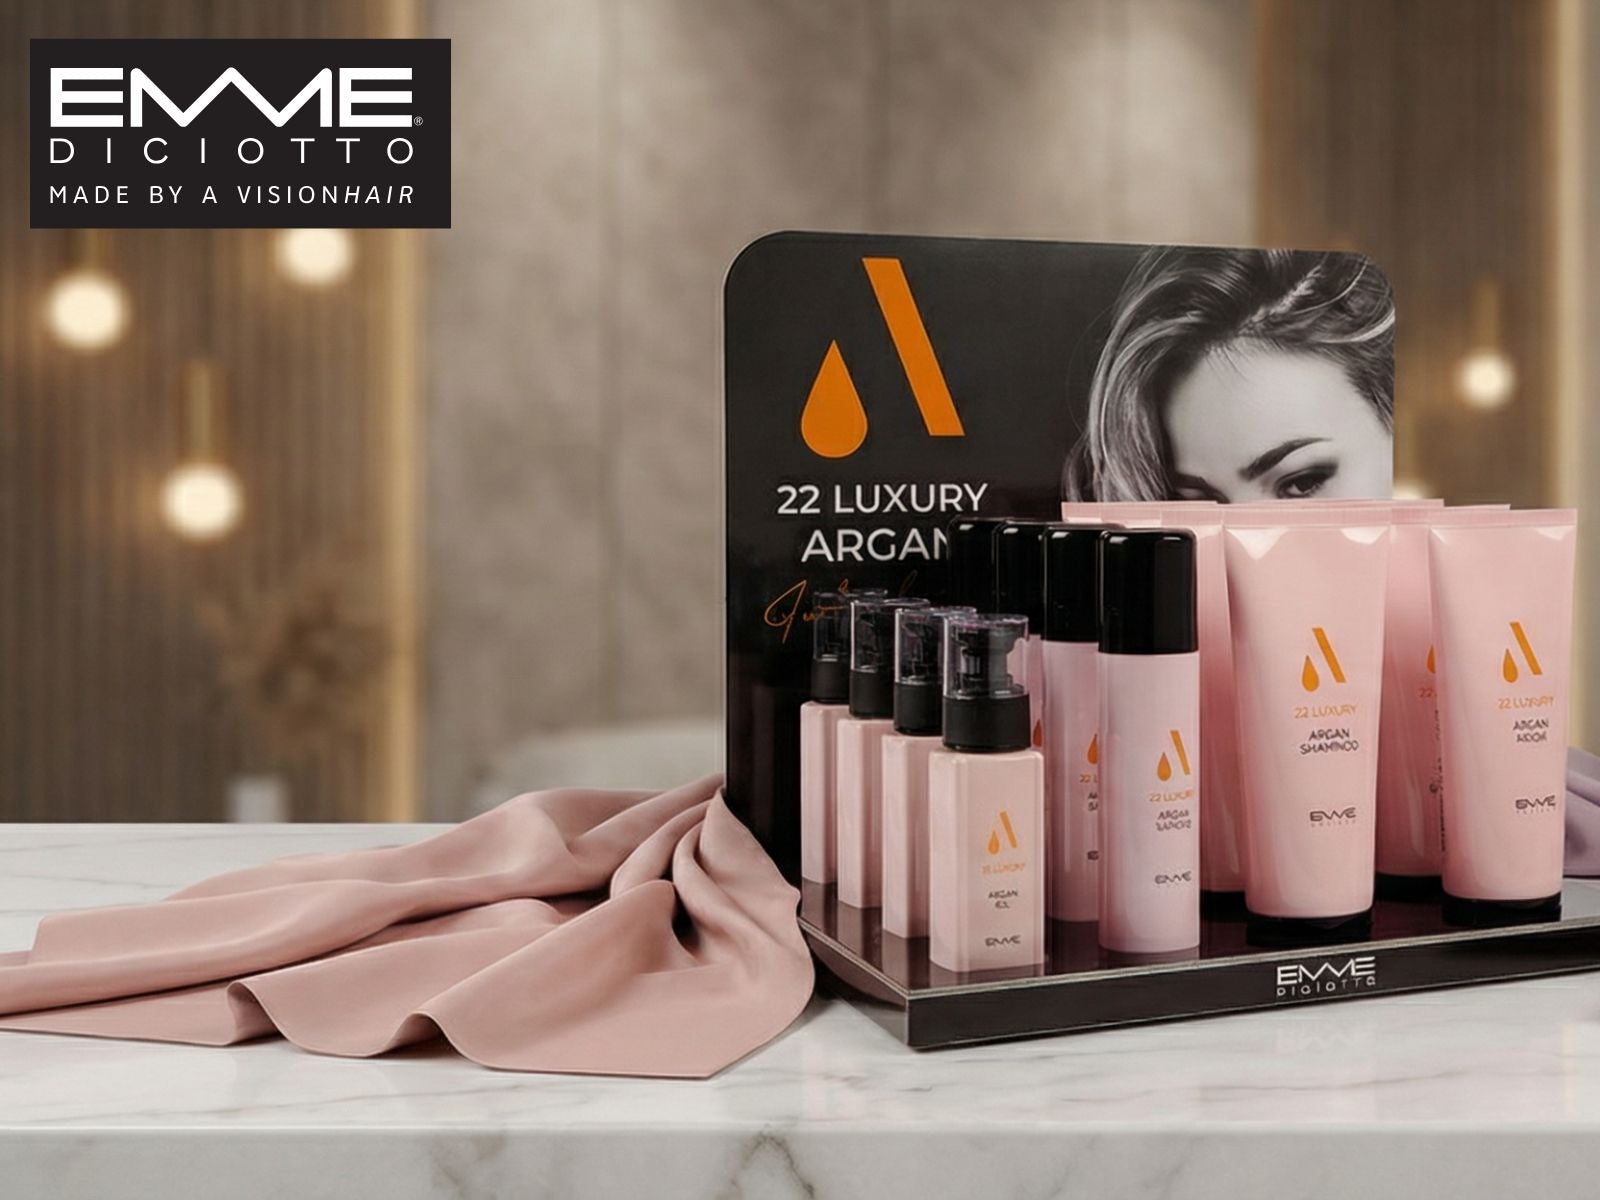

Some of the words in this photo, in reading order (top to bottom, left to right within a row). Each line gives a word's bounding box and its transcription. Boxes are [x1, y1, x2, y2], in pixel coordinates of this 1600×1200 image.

[777, 484, 821, 515] 22
[834, 482, 988, 513] LUXURY
[1277, 956, 1376, 985] EMME
